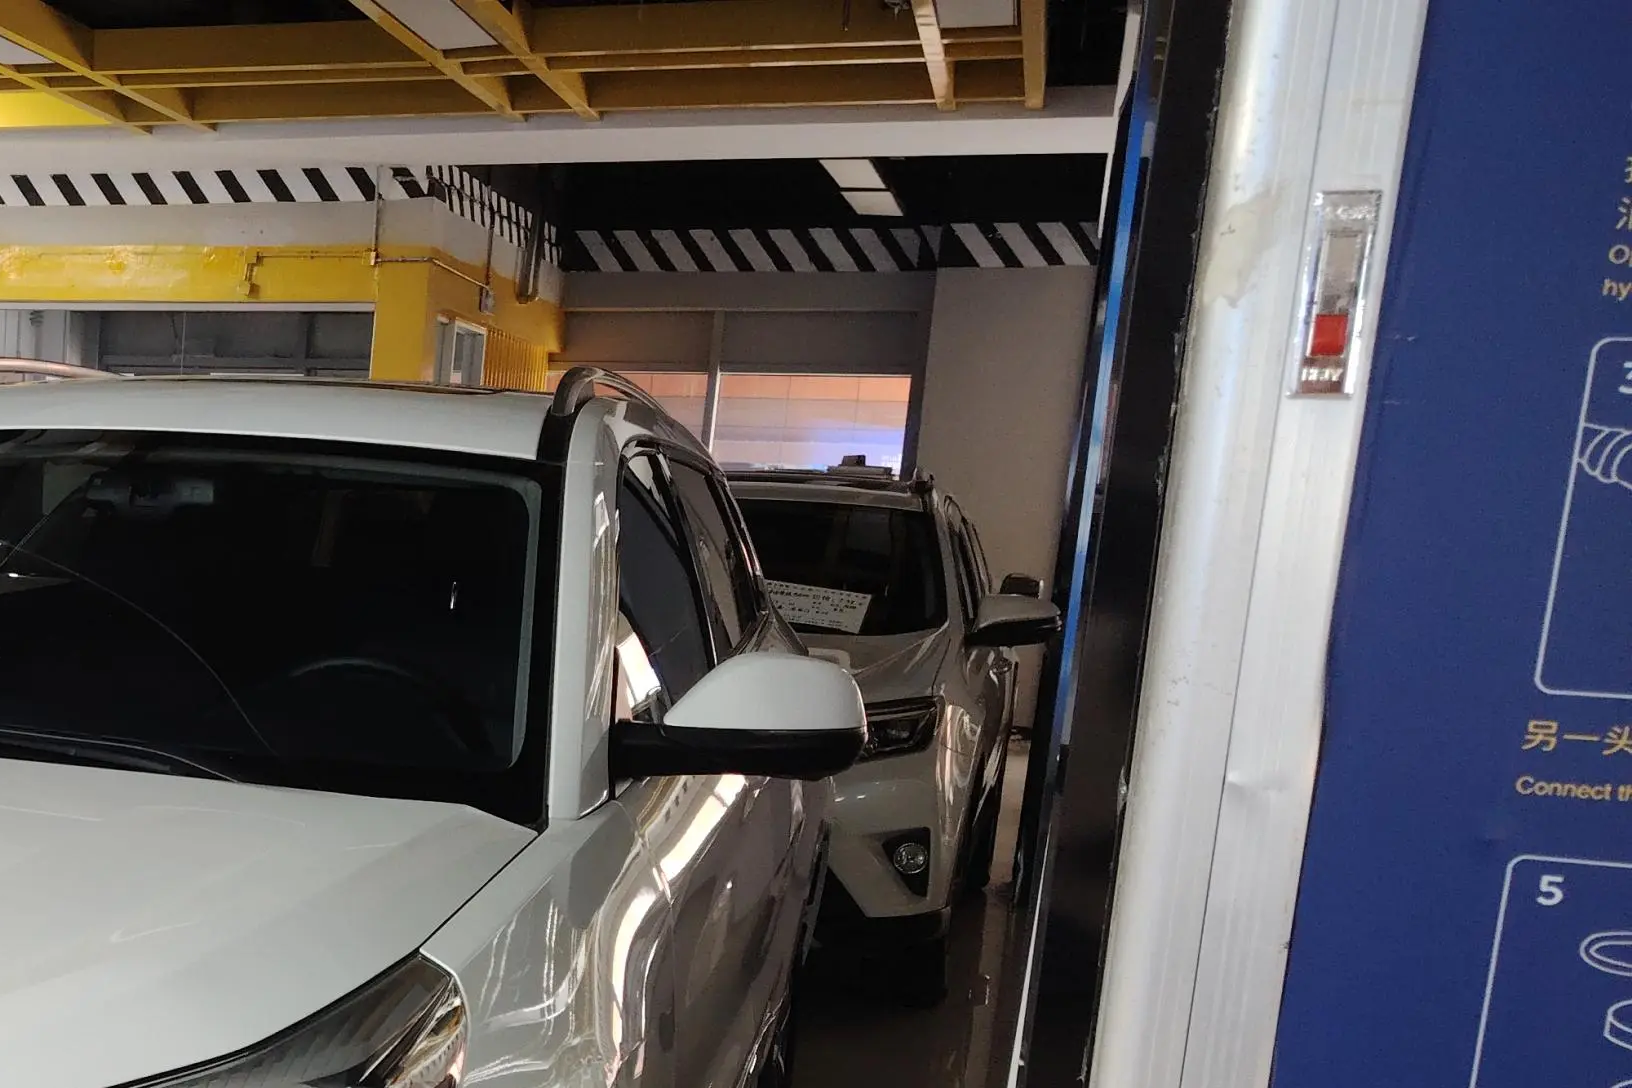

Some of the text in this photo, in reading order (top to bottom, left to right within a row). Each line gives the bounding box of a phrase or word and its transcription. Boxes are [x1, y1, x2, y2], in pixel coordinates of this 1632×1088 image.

[1521, 720, 1632, 756] 另一头
[1516, 775, 1612, 800] Connect
[1537, 875, 1565, 906] 5
